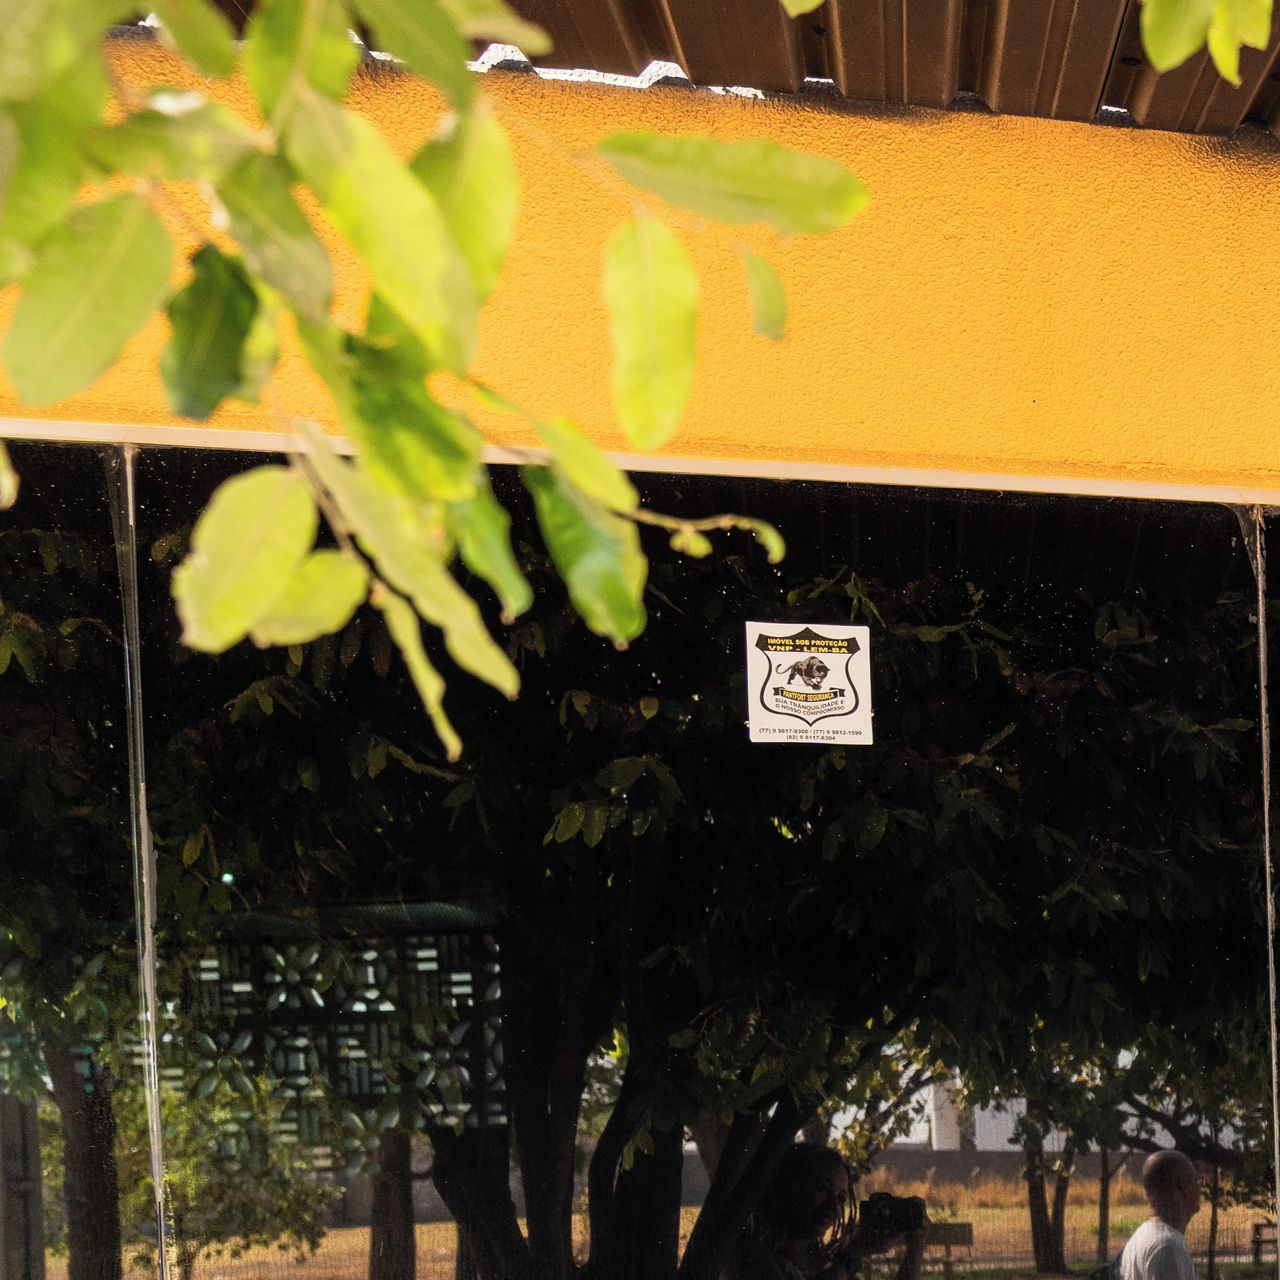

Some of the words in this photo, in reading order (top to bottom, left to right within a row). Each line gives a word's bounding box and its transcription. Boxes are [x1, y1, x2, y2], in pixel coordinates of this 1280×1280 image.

[811, 639, 848, 647] PROTEÇÃO
[781, 704, 801, 714] NOSSO
[802, 705, 845, 716] COMPROMISSO
[790, 700, 839, 711] TRANQUILIDADE
